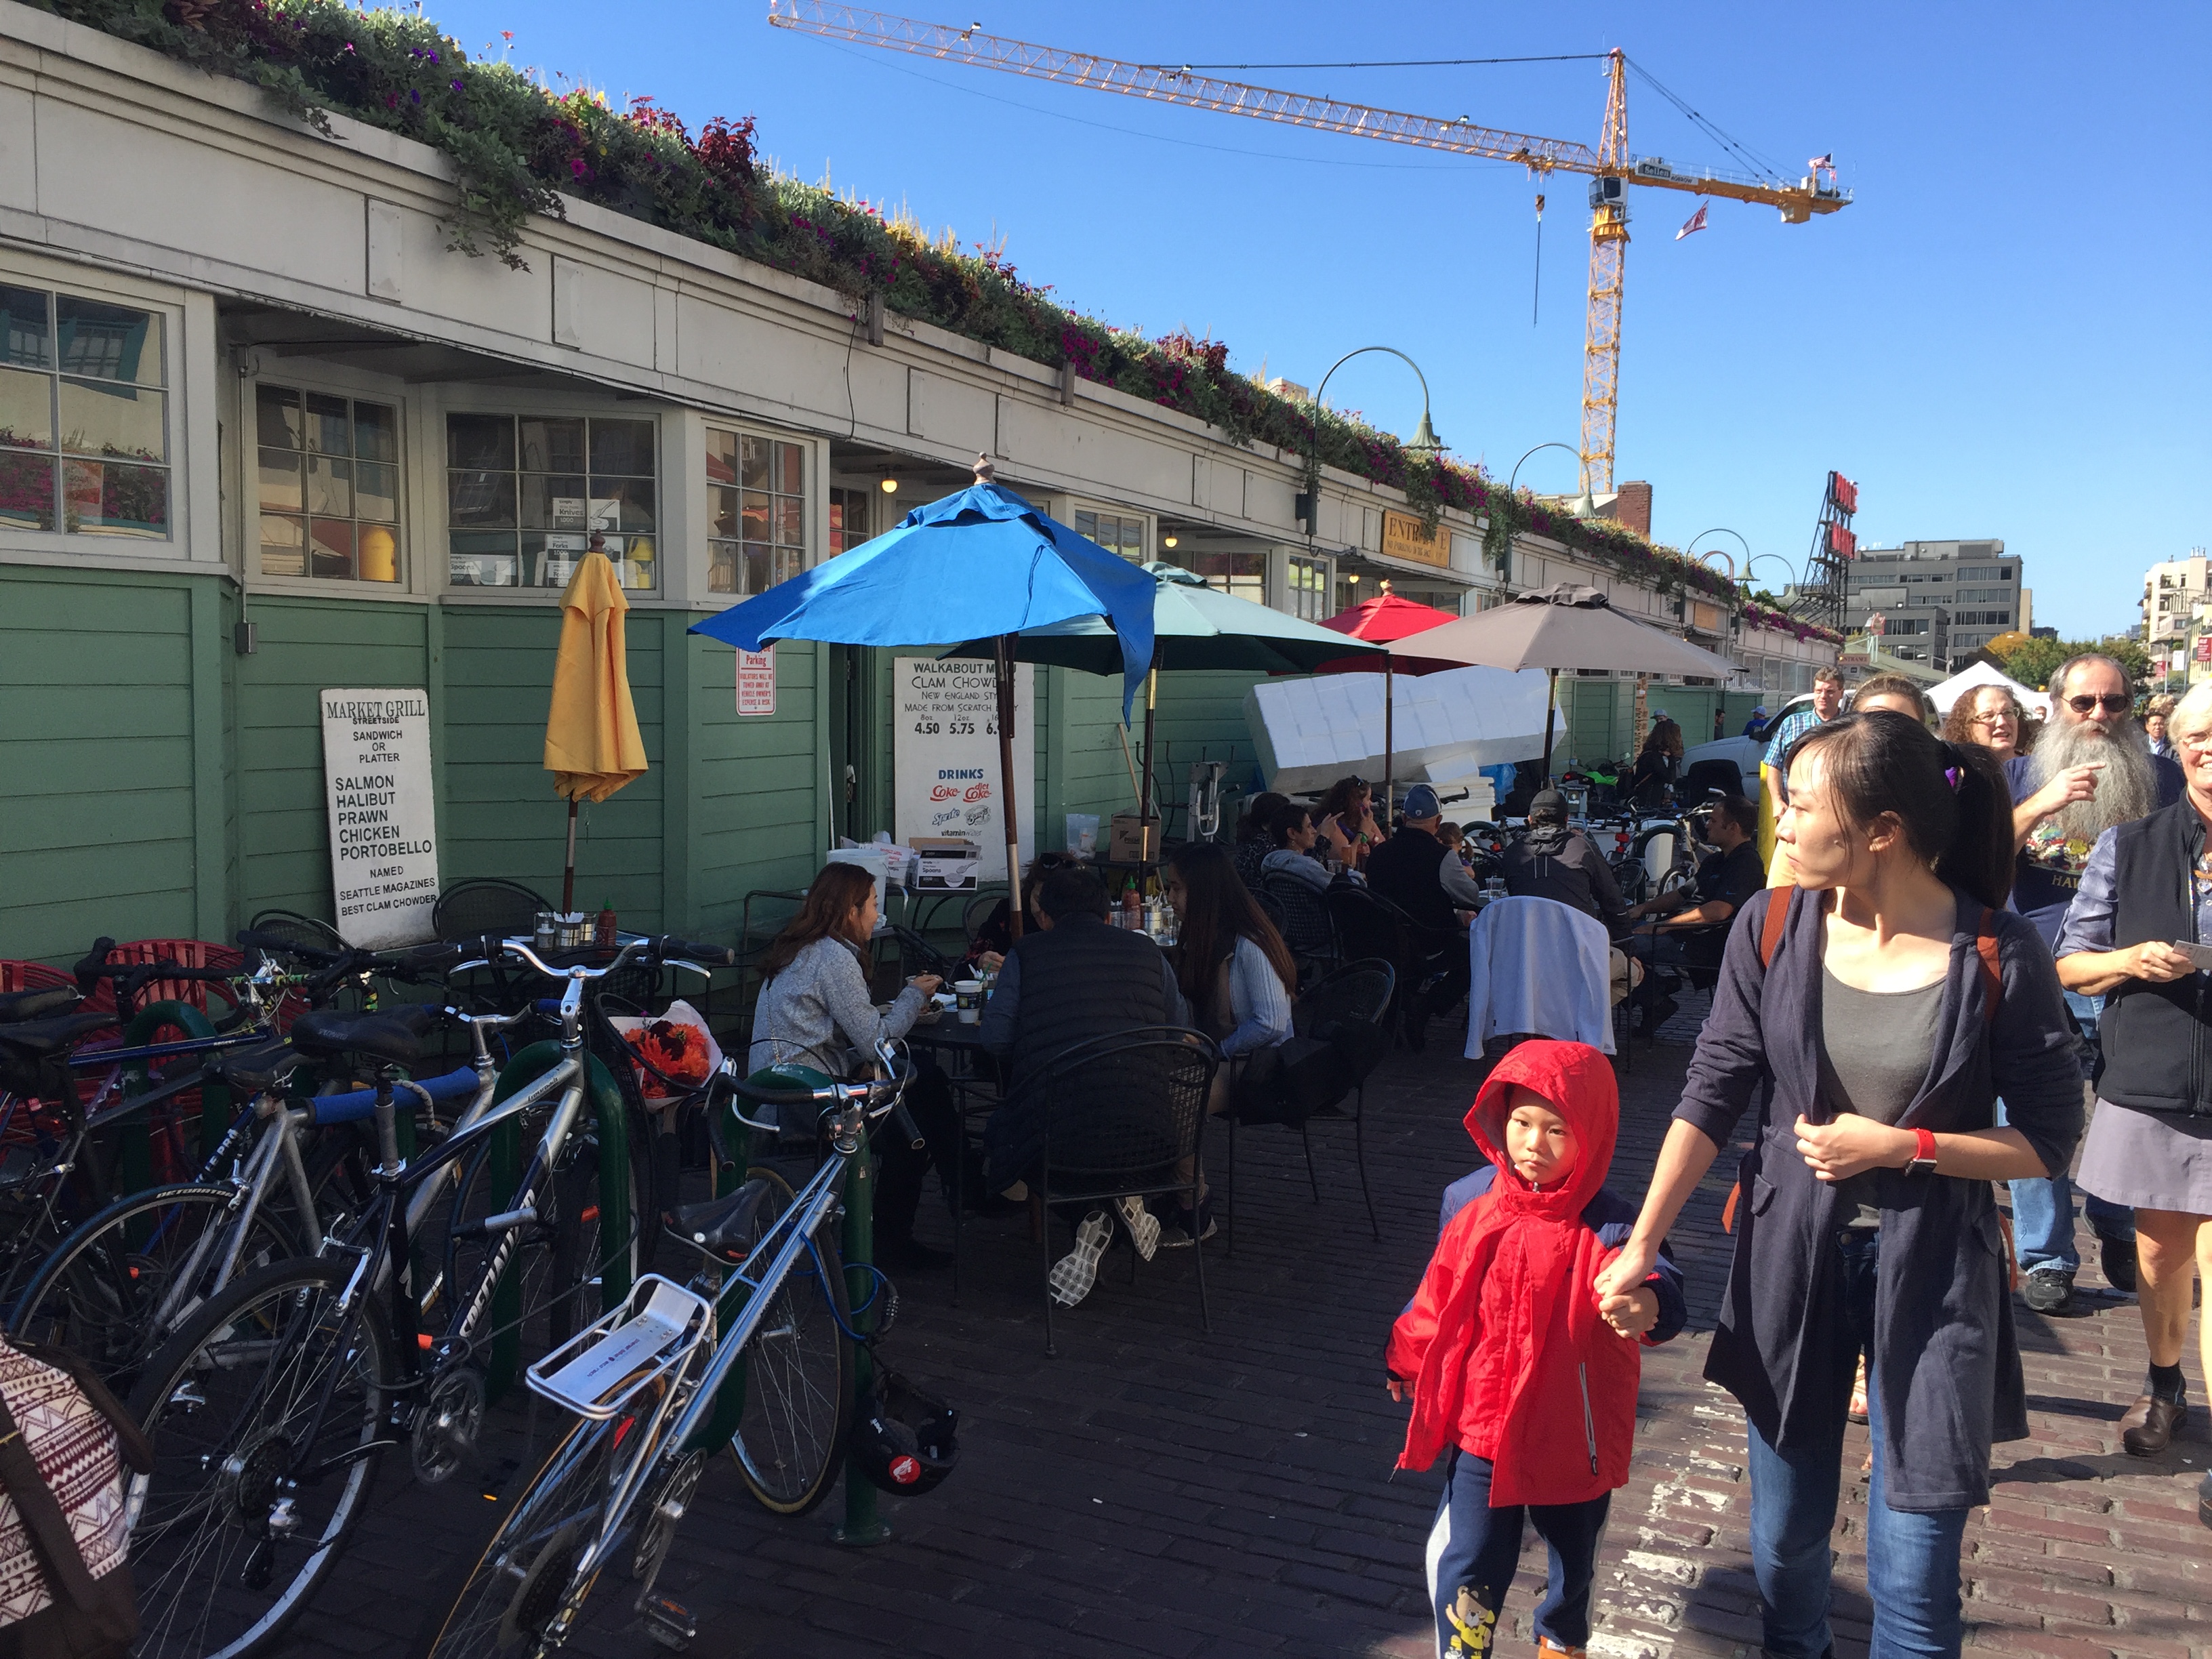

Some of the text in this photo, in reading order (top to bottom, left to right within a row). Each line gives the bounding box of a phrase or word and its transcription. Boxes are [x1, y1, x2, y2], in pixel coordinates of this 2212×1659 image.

[1644, 165, 1669, 176] Sellen
[746, 655, 766, 668] Parking
[914, 663, 983, 674] WALKABOUT
[912, 676, 946, 689] CLAM
[921, 691, 940, 700] NEW
[945, 692, 980, 700] ENGLAND
[326, 700, 426, 718] MARKET GRILL
[905, 703, 928, 712] MADE
[932, 703, 954, 712] FROM
[958, 703, 991, 712] SCRATCH
[352, 716, 400, 725] STREETSIDE
[914, 722, 940, 735] 4.50
[949, 722, 975, 735] 5.75
[353, 730, 403, 741] SANDWICH
[372, 742, 386, 752] OR
[359, 753, 400, 763] PLATTER
[939, 769, 984, 779] DRINKS
[335, 775, 394, 792] SALMON
[930, 785, 961, 801] Coke
[962, 786, 991, 802] Coke
[336, 792, 395, 808] HALIBUT
[338, 810, 388, 825] PRAWN
[932, 807, 960, 826] Sprite
[340, 825, 400, 844] CHICKEN
[340, 840, 432, 861] PORTOBELLO
[370, 866, 404, 878] NAMED
[340, 877, 436, 901] SEATTLE MAGAZINES
[342, 894, 437, 916] BEST CLAM CHOWDER
[156, 1188, 234, 1199] DETONATOR
